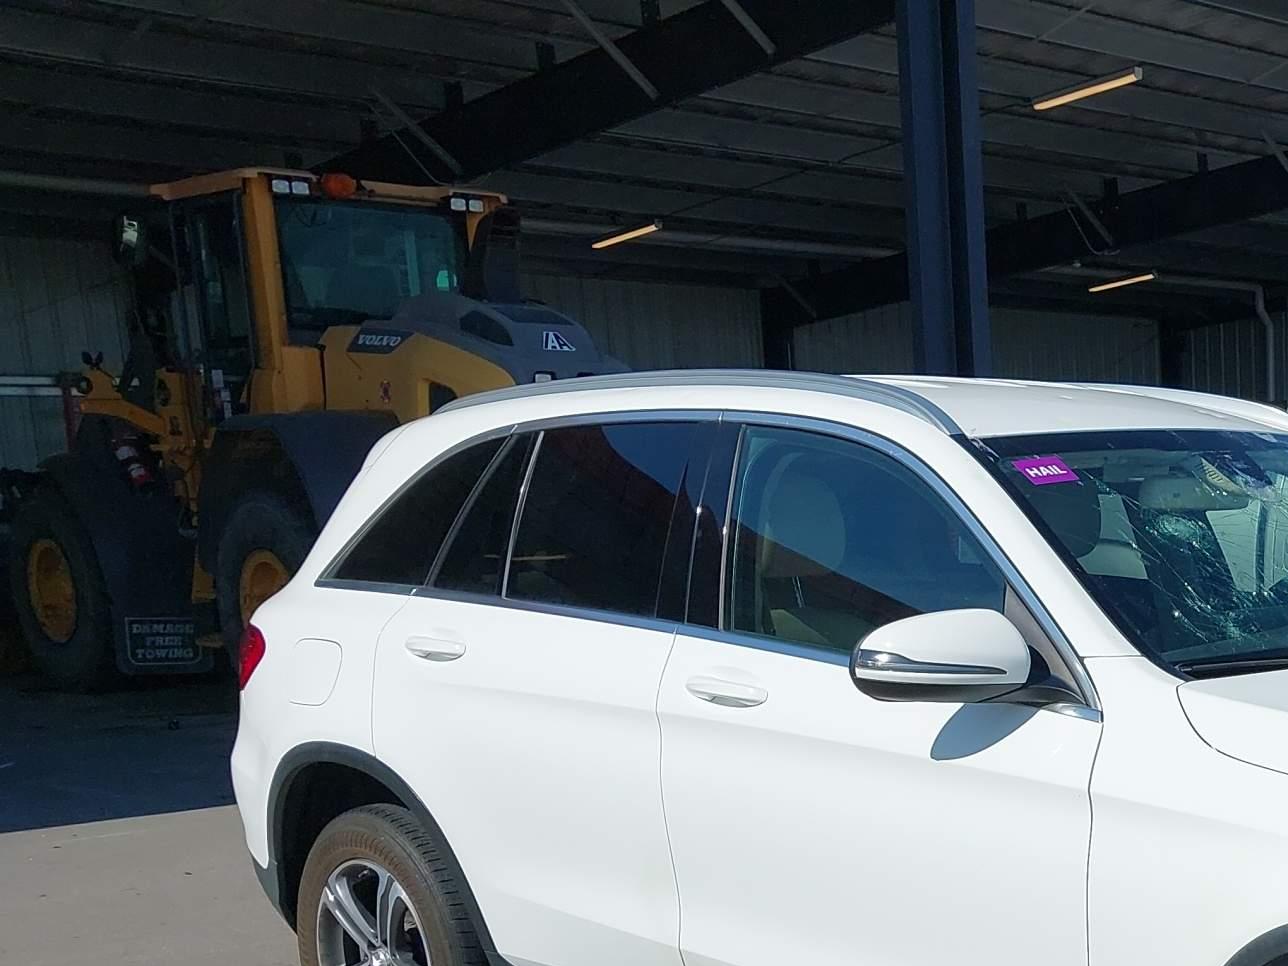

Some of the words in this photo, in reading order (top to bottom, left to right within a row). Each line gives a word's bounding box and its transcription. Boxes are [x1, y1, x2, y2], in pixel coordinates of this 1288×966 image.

[357, 334, 401, 347] VOLVO
[542, 331, 576, 351] IAA
[1025, 464, 1068, 478] HAIL
[135, 648, 194, 658] TOWING
